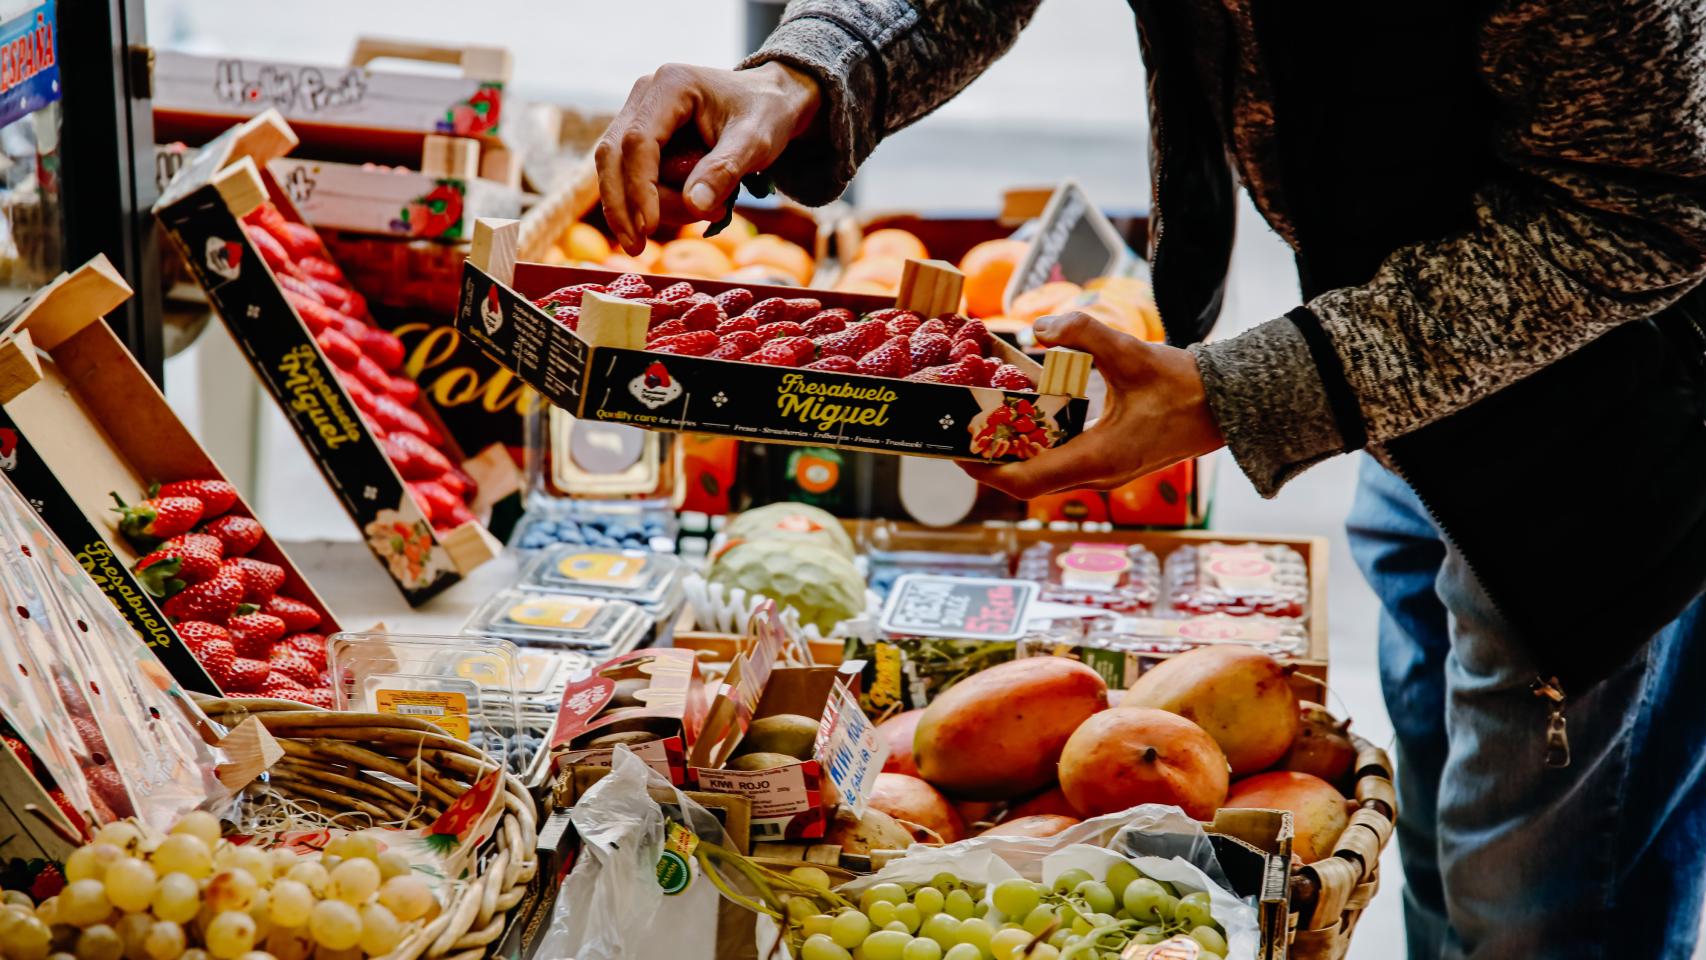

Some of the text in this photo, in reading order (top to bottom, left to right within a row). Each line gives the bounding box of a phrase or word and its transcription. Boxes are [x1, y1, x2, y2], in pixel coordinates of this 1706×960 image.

[278, 353, 350, 449] Miguel
[291, 343, 361, 443] Fresabuelo
[777, 373, 899, 402] Fresabuelo
[596, 409, 632, 420] Quality
[634, 414, 657, 423] care
[777, 393, 890, 431] Miguel
[84, 540, 171, 648] Fresabuelo
[710, 780, 734, 789] KIWI
[738, 780, 770, 790] ROJO
